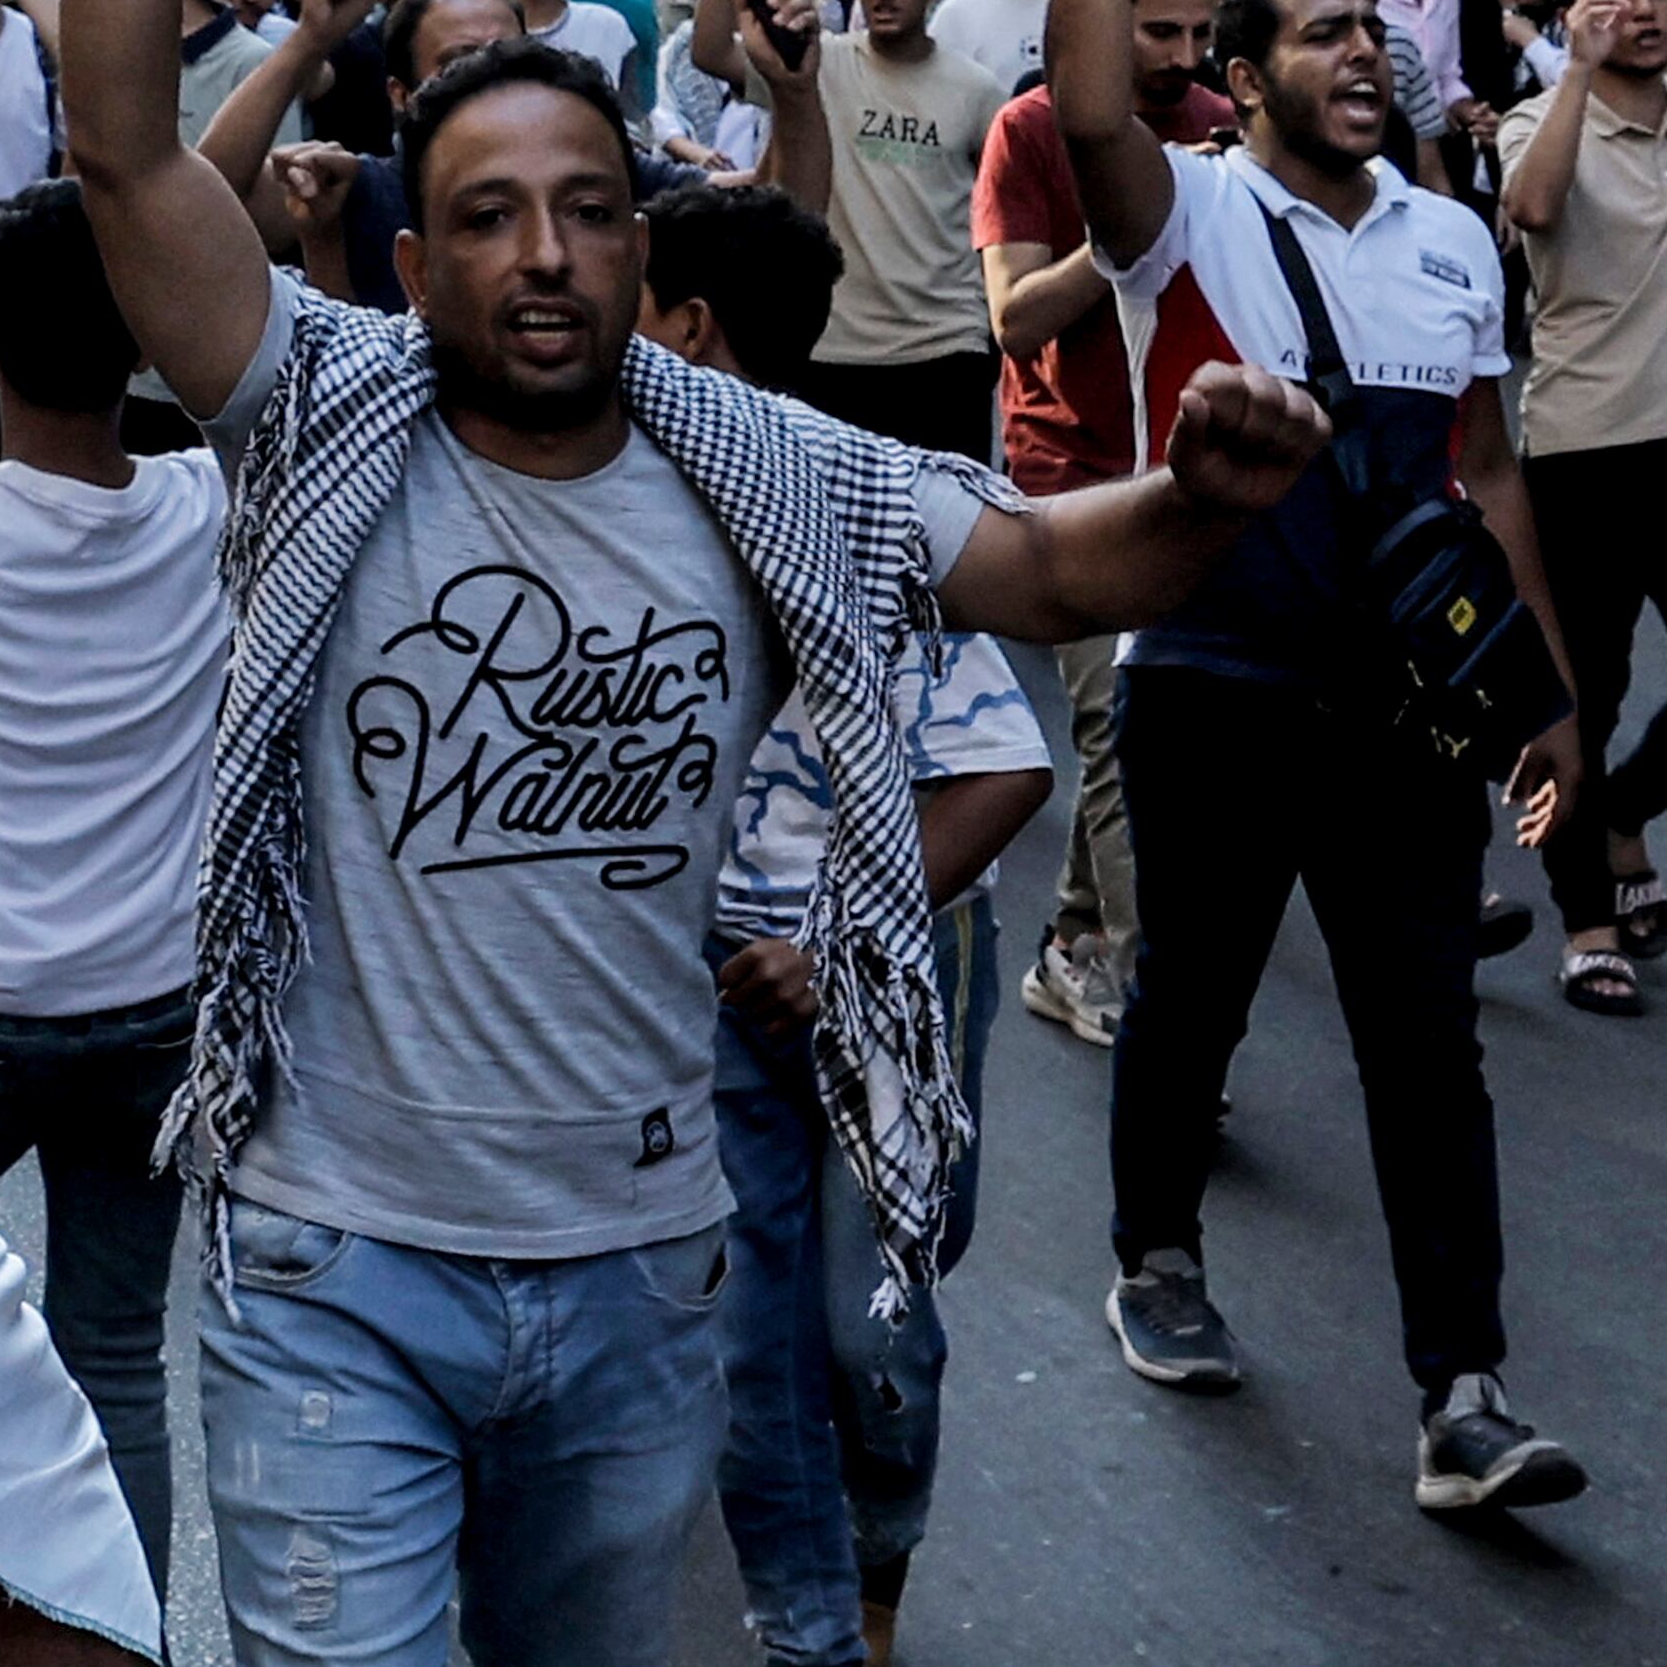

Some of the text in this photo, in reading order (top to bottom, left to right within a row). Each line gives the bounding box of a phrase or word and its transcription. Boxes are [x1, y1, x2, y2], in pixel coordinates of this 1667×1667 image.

[859, 109, 940, 146] ZARA
[1279, 338, 1460, 385] ATLETICS
[380, 564, 730, 742] Rustic
[345, 675, 719, 860] Walnut
